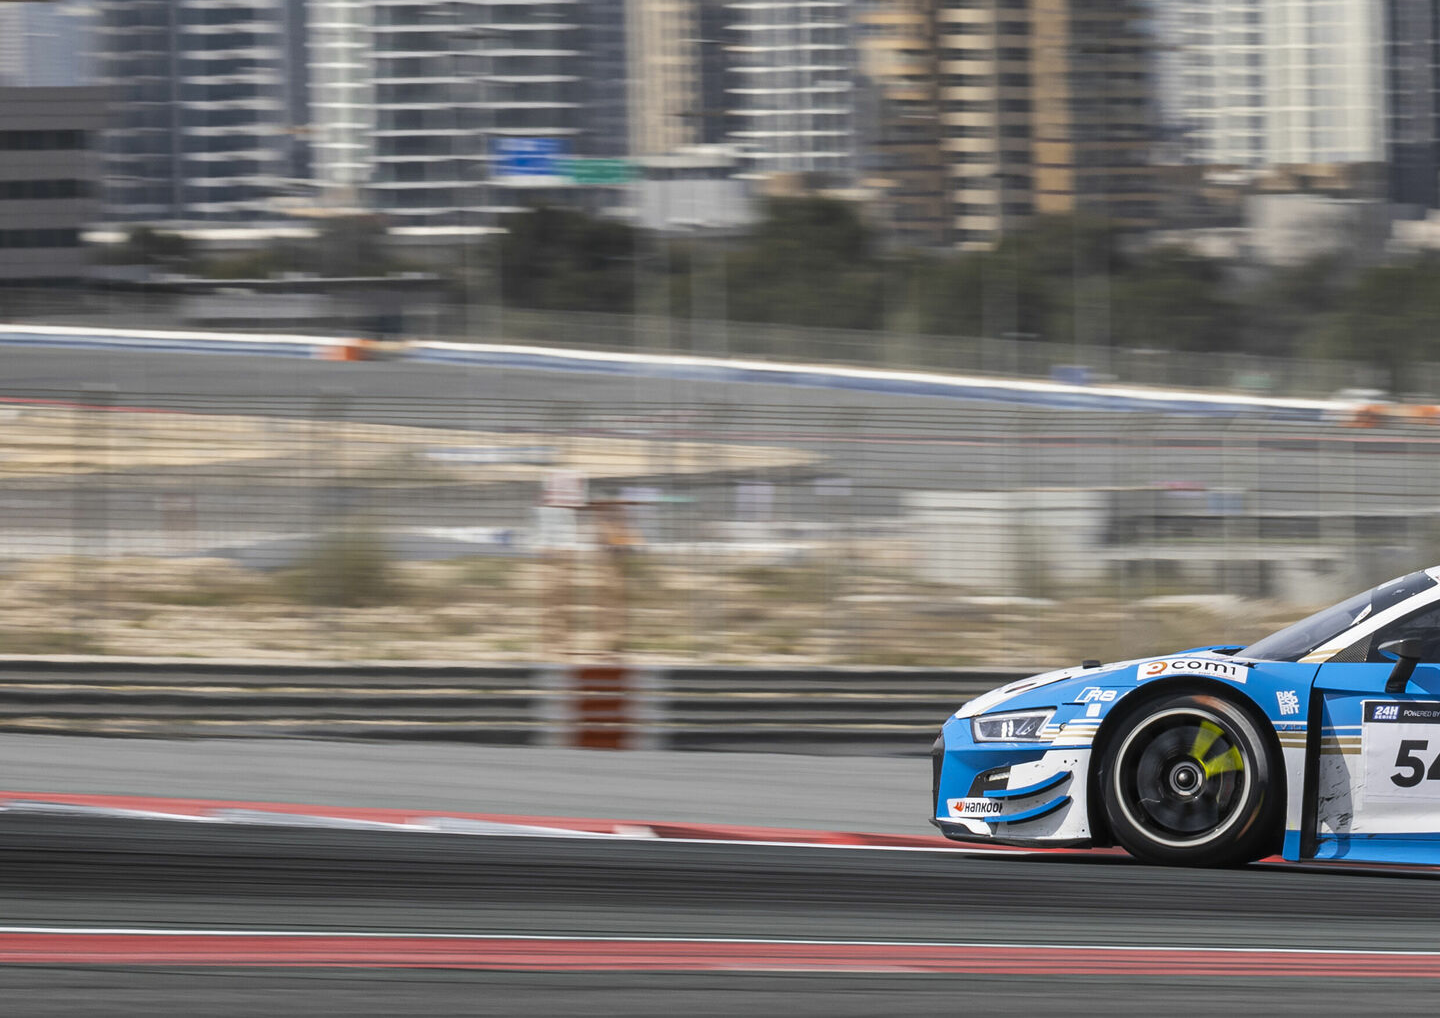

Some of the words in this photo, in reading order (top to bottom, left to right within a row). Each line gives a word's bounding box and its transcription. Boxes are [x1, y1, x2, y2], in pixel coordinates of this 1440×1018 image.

[1375, 706, 1399, 715] 24H
[1403, 709, 1432, 718] POWERED
[1432, 710, 1440, 718] BY
